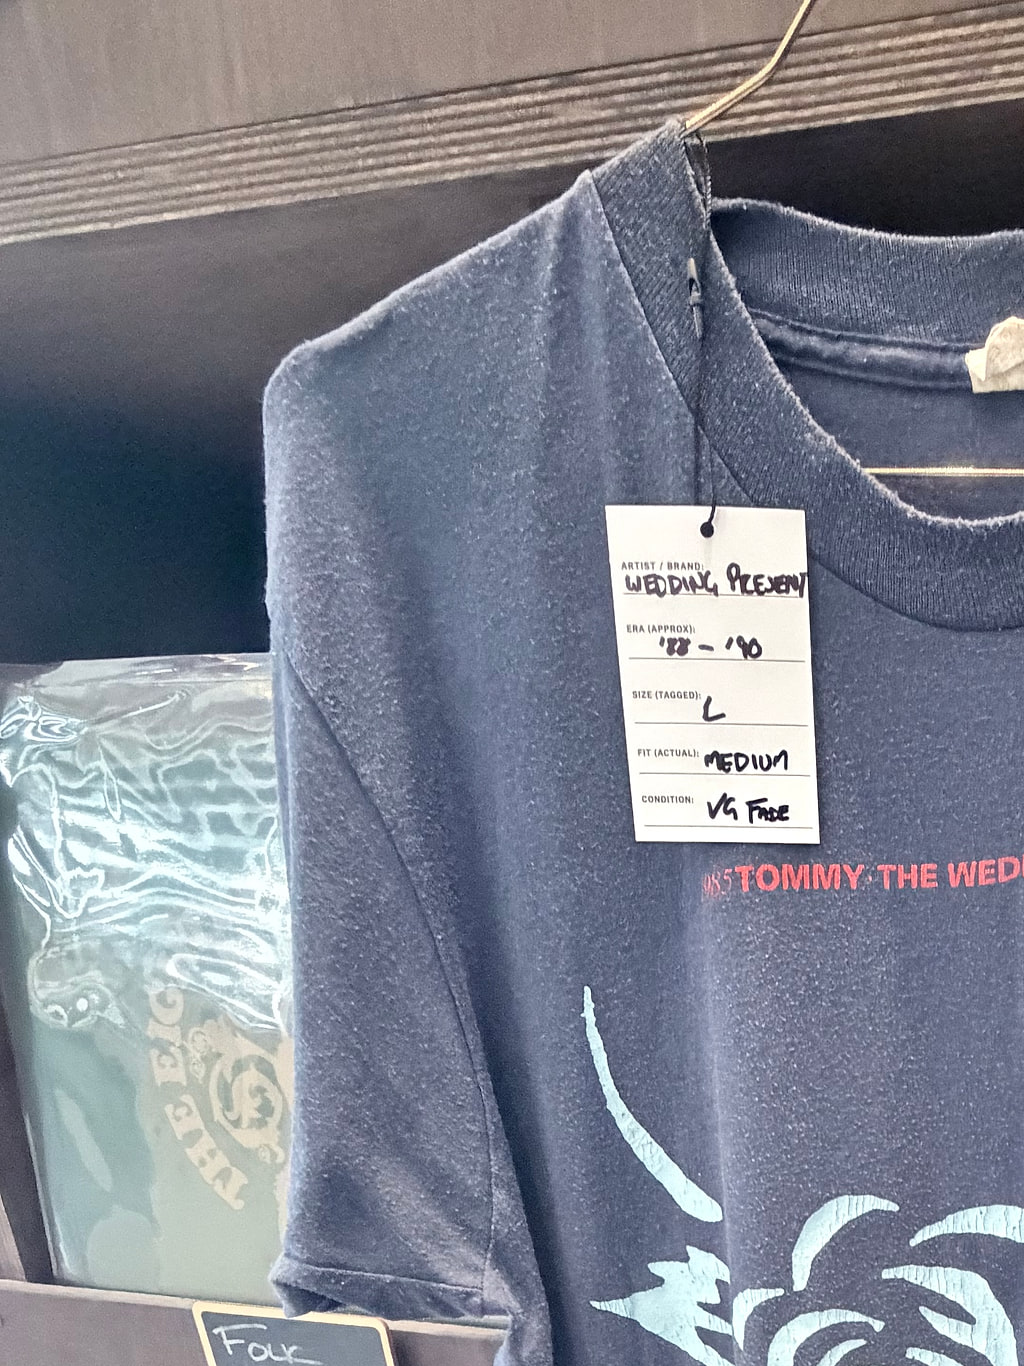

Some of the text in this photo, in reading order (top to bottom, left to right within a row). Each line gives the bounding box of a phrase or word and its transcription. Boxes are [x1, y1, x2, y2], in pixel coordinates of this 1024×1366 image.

[621, 562, 656, 571] ARTIST
[667, 562, 704, 571] BRAND:
[625, 570, 719, 598] WEDDING
[626, 624, 696, 633] ERA (APPROX):
[632, 690, 702, 700] SIZE (TAGGED):
[702, 695, 726, 722] L
[637, 749, 700, 758] FIT (ACTUAL):
[704, 749, 788, 773] MEDIUM
[641, 795, 694, 804] CONDITION:
[706, 792, 738, 821] VG
[734, 863, 865, 893] TOMMY
[877, 863, 938, 890] THE
